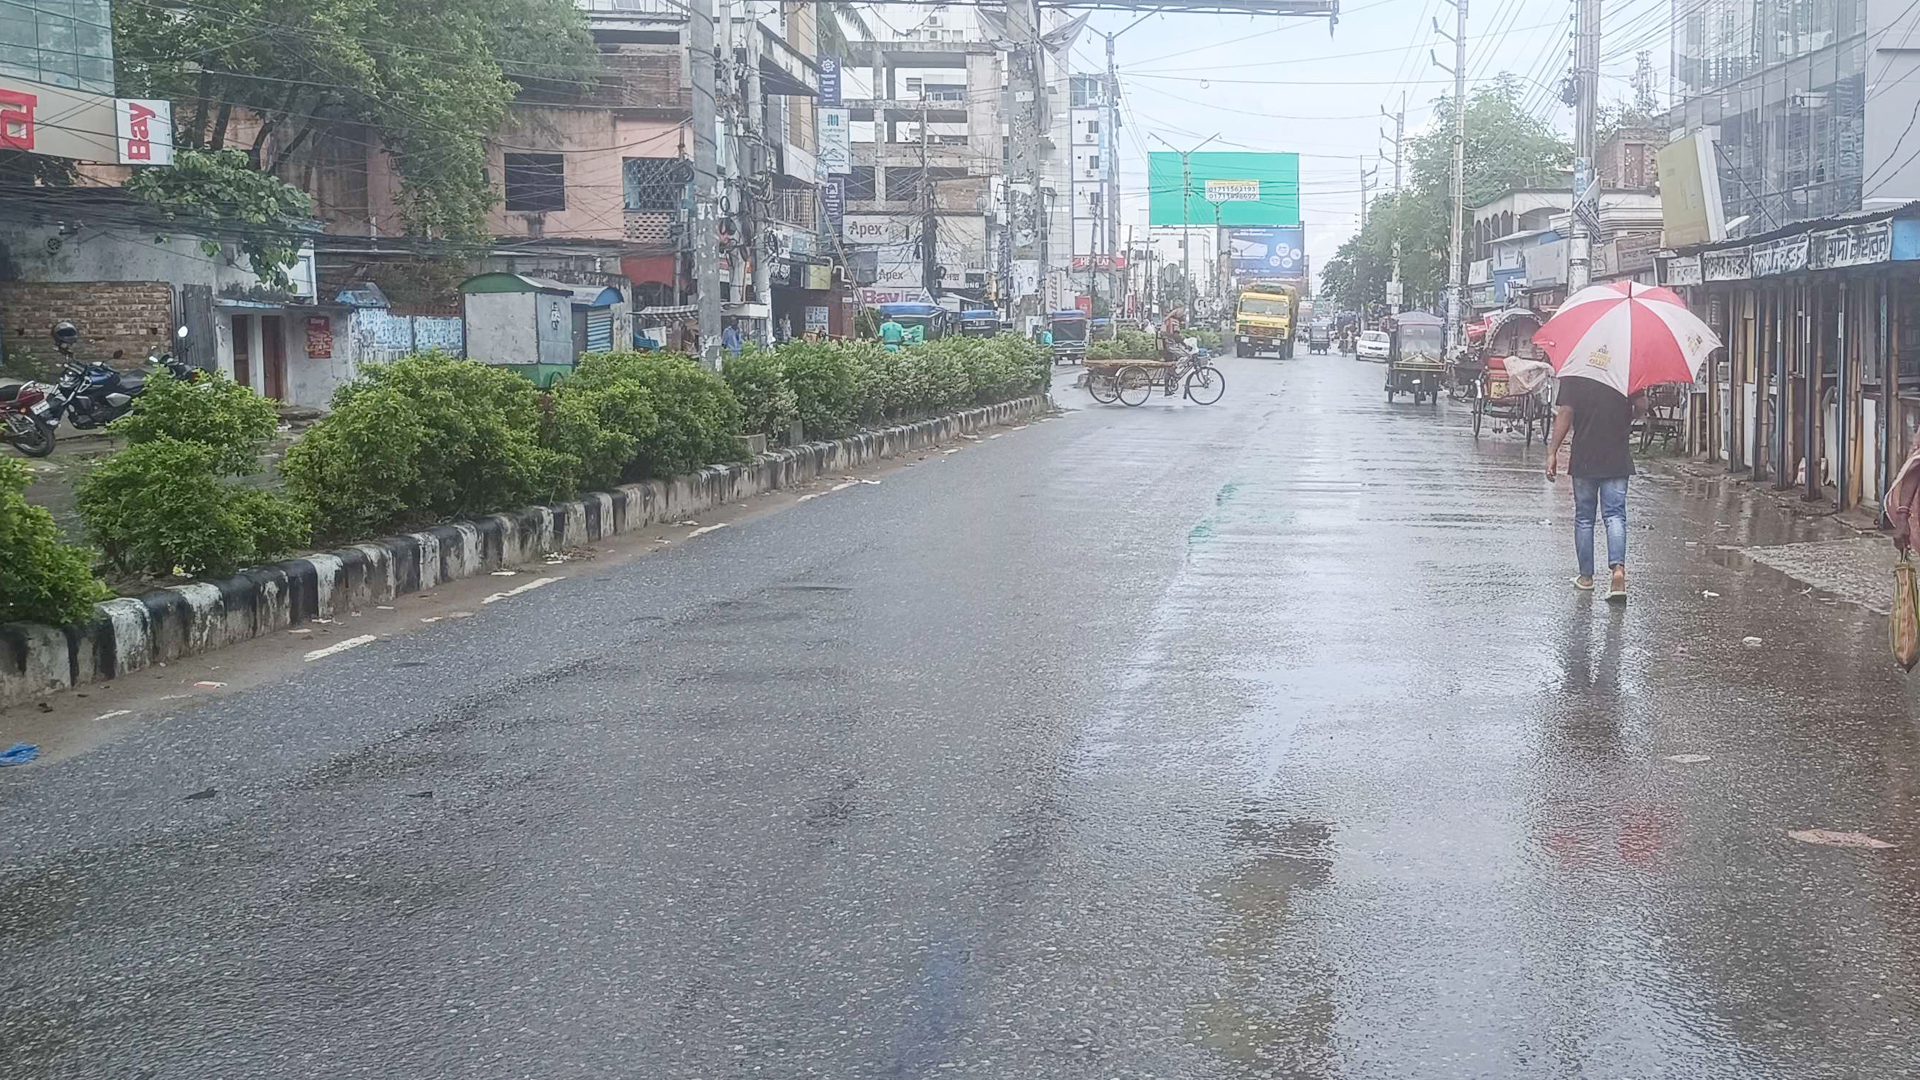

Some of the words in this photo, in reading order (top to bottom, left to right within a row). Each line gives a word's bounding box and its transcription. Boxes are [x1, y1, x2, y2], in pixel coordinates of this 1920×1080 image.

[128, 103, 156, 160] Bay
[848, 221, 882, 238] Apex
[879, 268, 904, 281] Apex
